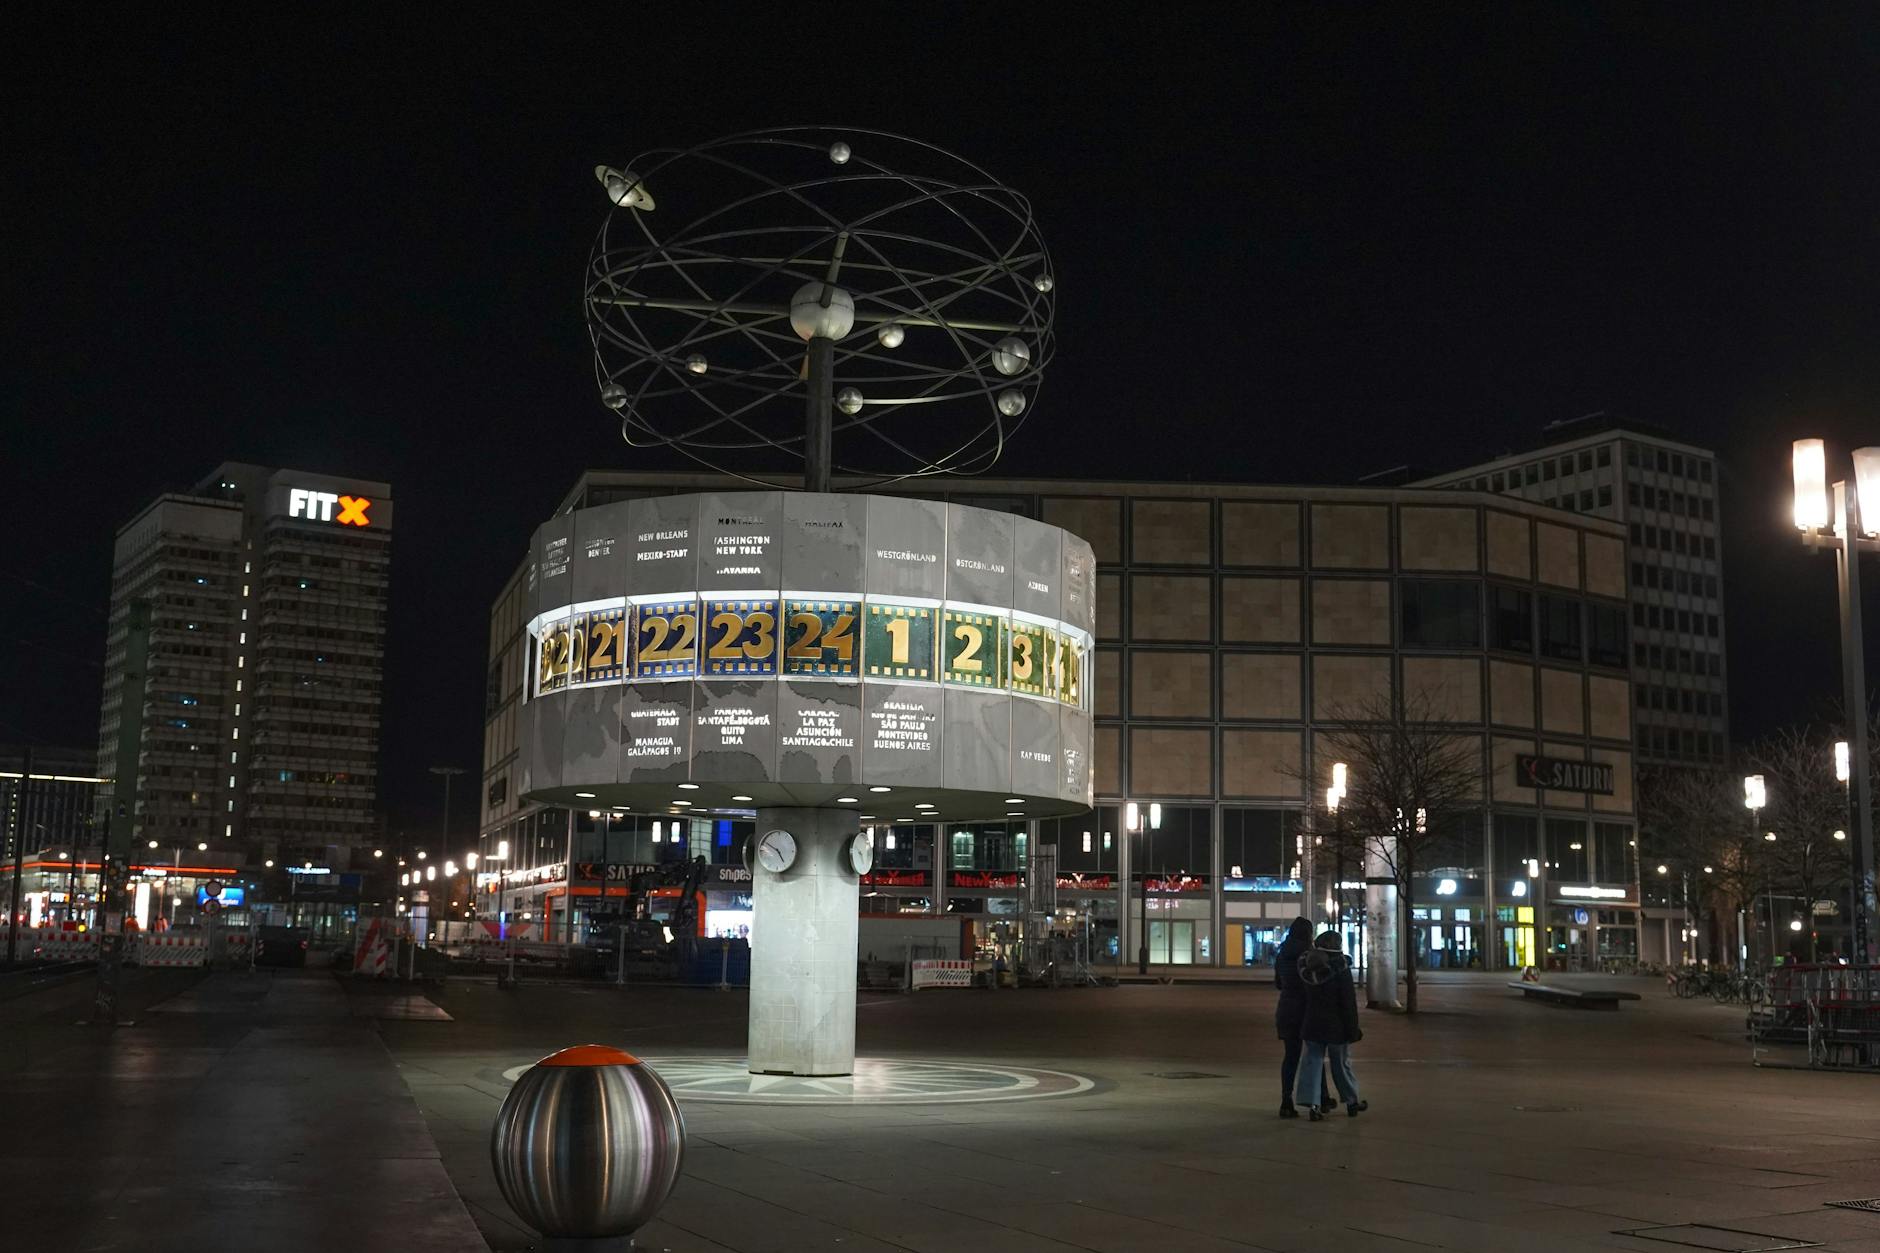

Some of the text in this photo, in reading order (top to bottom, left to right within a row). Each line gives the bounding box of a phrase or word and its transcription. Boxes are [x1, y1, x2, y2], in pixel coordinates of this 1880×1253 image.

[289, 488, 371, 527] FITX
[638, 530, 688, 543] NEW ORLEANS
[636, 549, 688, 562] MEXIKO-STADT
[716, 546, 763, 555] NEW YORK
[877, 550, 937, 563] WESTGRÖNLAND
[639, 614, 696, 663] 22
[709, 612, 775, 660] 23
[787, 612, 856, 660] 24
[886, 618, 910, 664] 1
[589, 620, 624, 668] 21
[952, 625, 983, 671] 2
[1012, 634, 1033, 680] 3
[656, 717, 680, 727] STADT
[803, 718, 836, 728] LA PAZ
[881, 719, 926, 731] SÃO PAULO
[721, 726, 746, 736] QUITO
[796, 727, 842, 737] ASUNCIÓN
[877, 730, 929, 741] MONTEVIDEO
[635, 737, 674, 747] MANAGUA
[721, 736, 744, 745] LIMA
[782, 736, 854, 747] SANTIAGO-CHILE
[874, 740, 931, 751] BUENOS AIRES
[628, 746, 670, 757] GALÁPAGOS
[1020, 750, 1033, 759] KAP
[1554, 762, 1613, 791] SATURN
